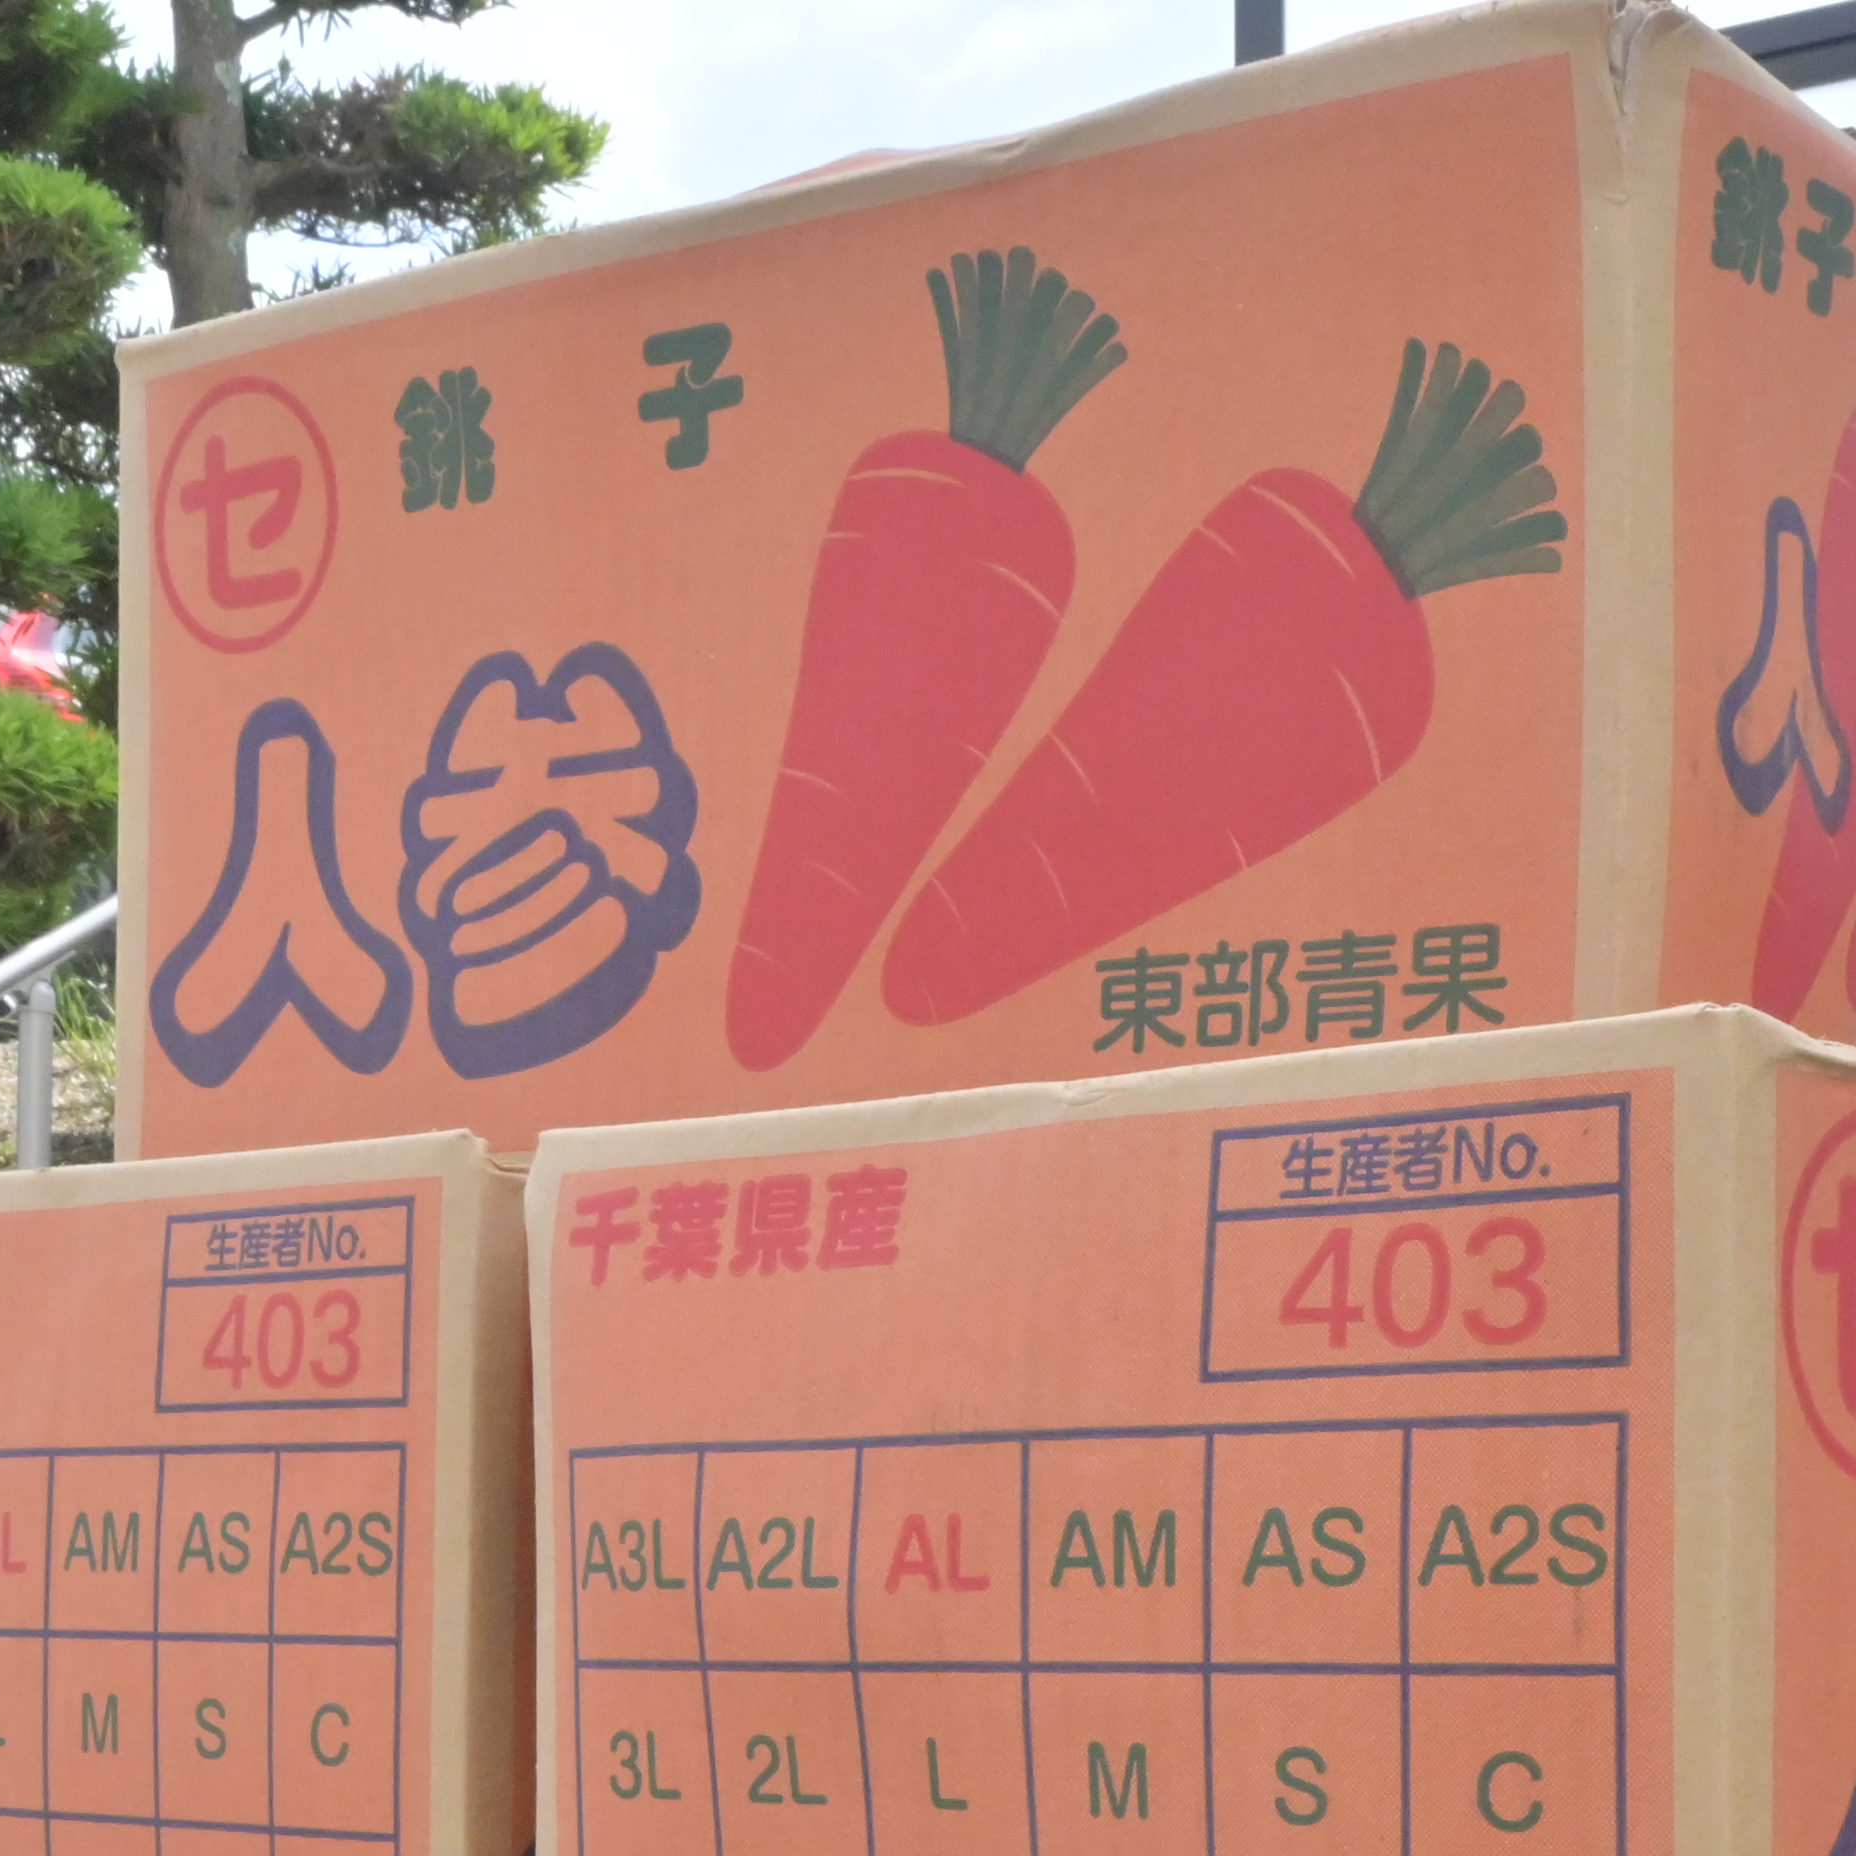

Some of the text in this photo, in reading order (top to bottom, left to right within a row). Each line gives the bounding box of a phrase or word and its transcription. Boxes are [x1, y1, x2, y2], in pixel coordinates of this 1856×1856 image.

[1092, 923, 1508, 1055] 東部青果
[1280, 1123, 1551, 1203] 生産者No.
[204, 1215, 368, 1274] 生産者No.
[567, 1163, 908, 1286] 千葉県産
[1278, 1217, 1546, 1352] 403
[202, 1288, 363, 1391] 403
[63, 1510, 140, 1574] AM
[176, 1511, 252, 1575] AS
[280, 1511, 395, 1577] A2S
[580, 1502, 1610, 1596] A3L A2L AL AM AS A2S
[81, 1693, 120, 1755] M
[194, 1699, 228, 1760] S
[310, 1703, 351, 1767] C
[607, 1731, 1545, 1834] 3L 2L L M S C
